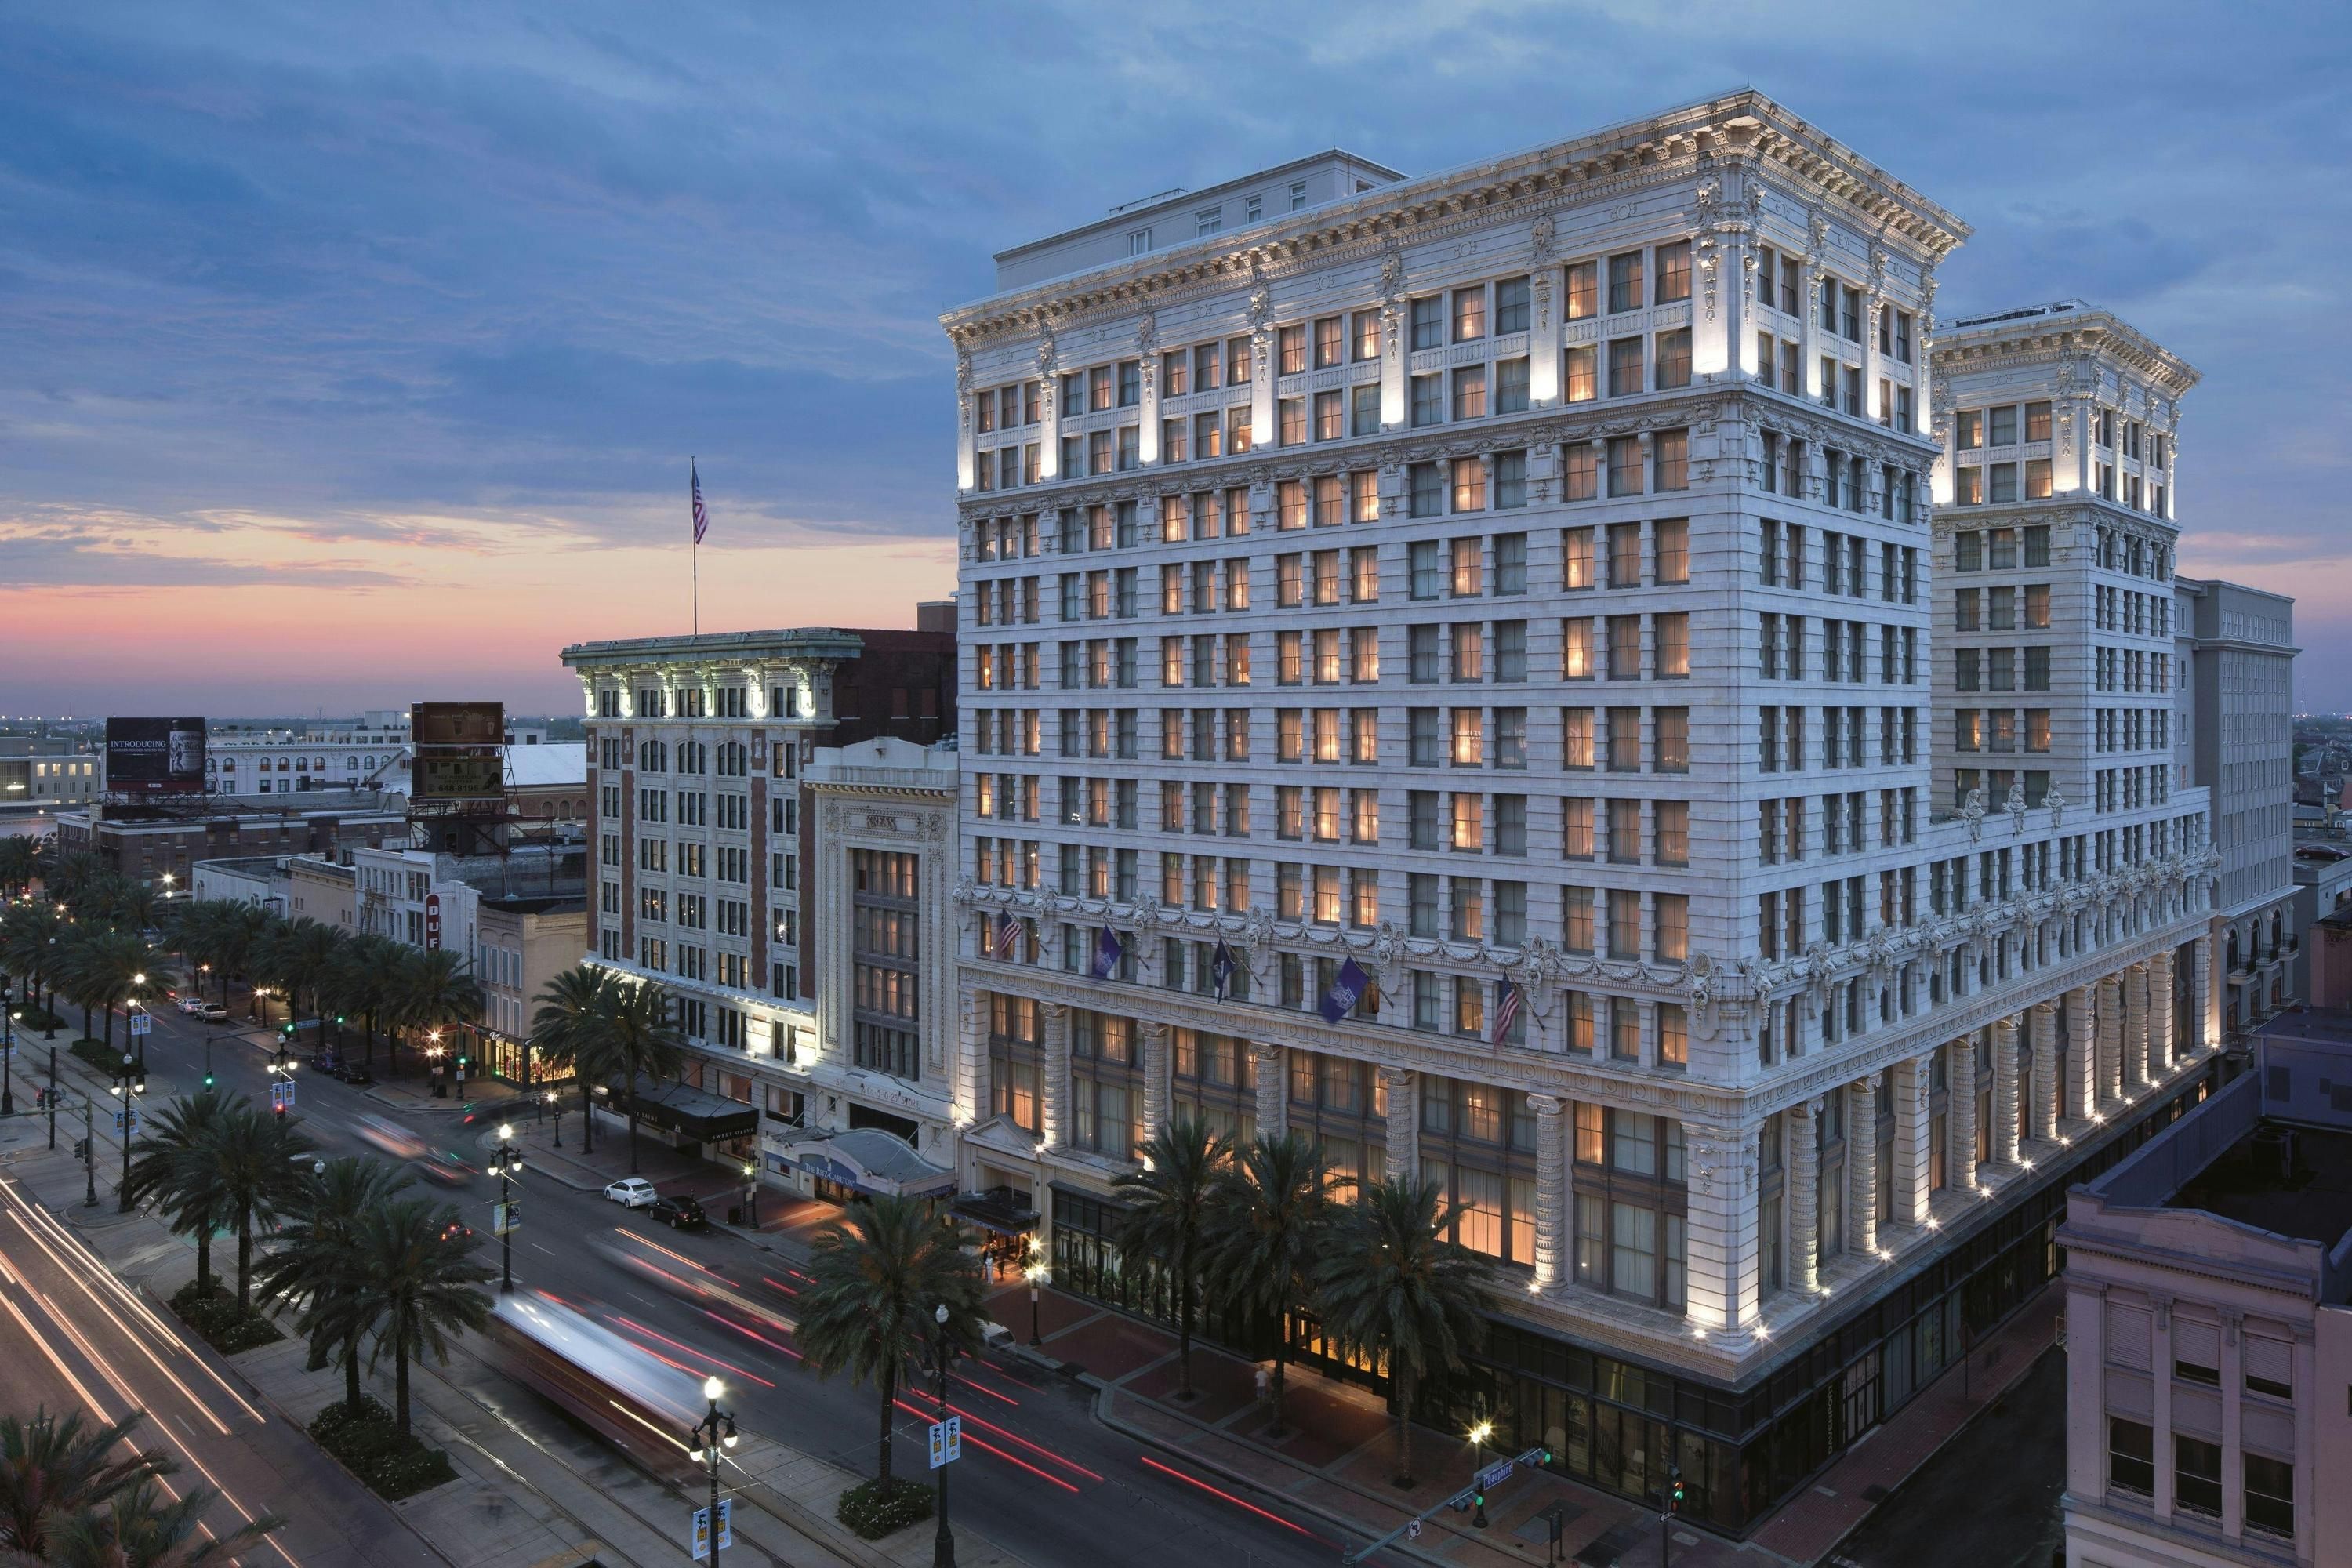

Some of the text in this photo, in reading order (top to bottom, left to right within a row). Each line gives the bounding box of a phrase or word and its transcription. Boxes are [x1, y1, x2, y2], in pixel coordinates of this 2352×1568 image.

[866, 815, 897, 831] KRESS
[712, 1127, 754, 1141] SWEET OLIVE
[805, 1163, 815, 1174] THE
[1487, 1465, 1512, 1485] Dauphine
